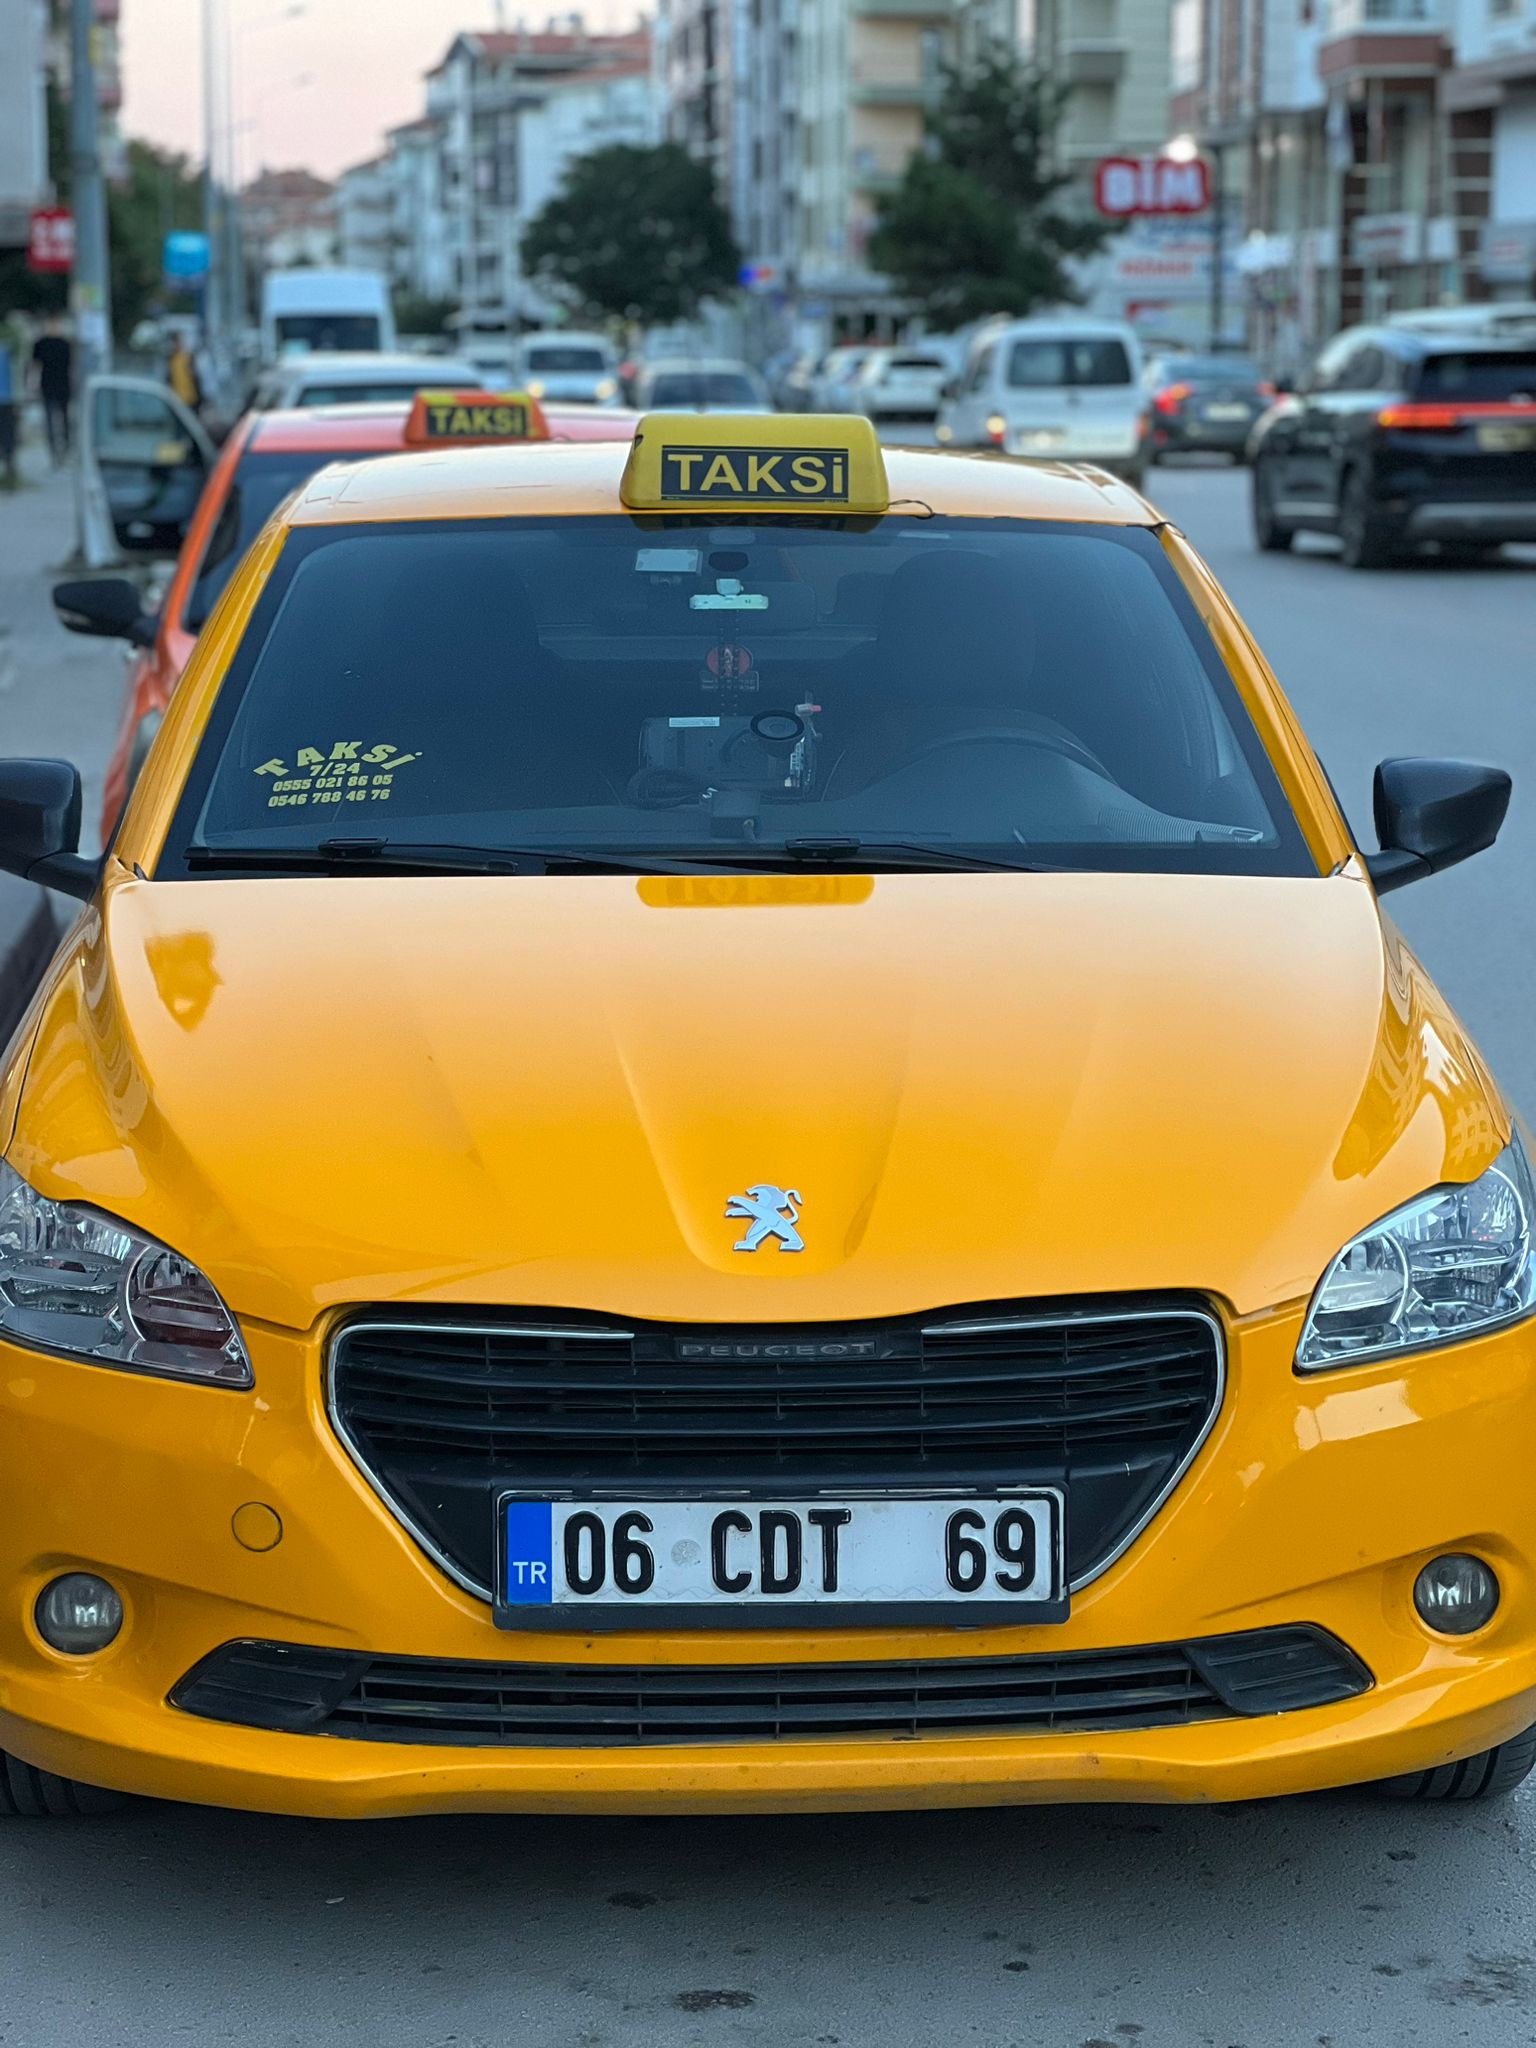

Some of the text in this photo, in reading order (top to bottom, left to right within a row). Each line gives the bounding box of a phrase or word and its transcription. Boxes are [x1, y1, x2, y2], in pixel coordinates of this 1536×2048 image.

[310, 761, 360, 777] 7/24
[272, 778, 312, 792] 0555
[315, 776, 342, 788] 021
[372, 774, 393, 785] 05
[267, 793, 307, 808] 0546
[345, 789, 366, 801] 46
[371, 788, 391, 800] 76
[681, 1342, 874, 1356] PEUGEOT
[563, 1507, 1037, 1595] 06 CDT 69
[512, 1561, 547, 1585] TR
